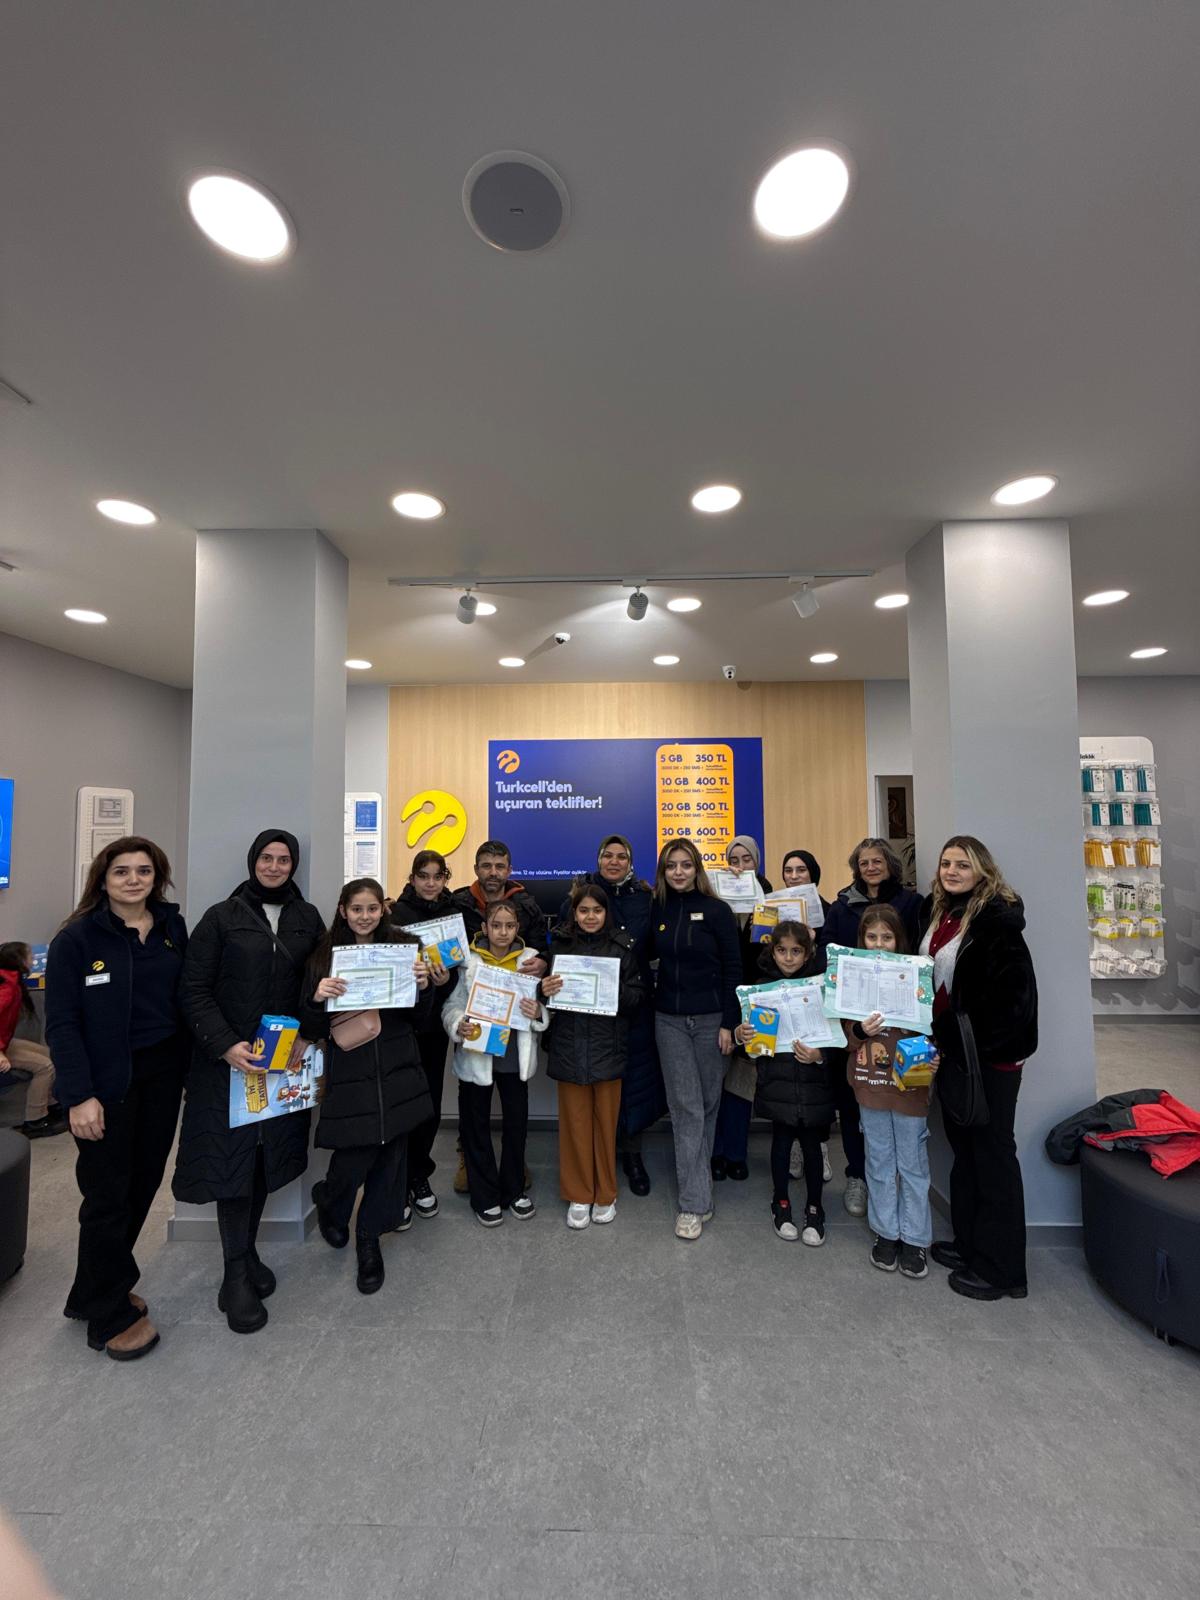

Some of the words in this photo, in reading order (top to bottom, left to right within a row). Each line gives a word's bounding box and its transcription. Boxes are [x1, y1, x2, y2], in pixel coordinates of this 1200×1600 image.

[660, 754, 666, 763] 5
[668, 754, 683, 762] GB
[695, 754, 714, 762] 350
[716, 754, 727, 762] TL
[661, 777, 672, 786] 10
[674, 777, 689, 785] GB
[696, 777, 716, 785] 400
[719, 777, 730, 785] TL
[495, 780, 573, 793] Turkcell'den
[495, 799, 542, 813] uçuran
[545, 796, 603, 809] teklifler!
[661, 802, 674, 811] 20
[676, 802, 691, 811] GB
[696, 802, 716, 811] 500
[718, 802, 729, 811] TL
[661, 827, 674, 836] 30
[677, 827, 691, 836] GB
[696, 827, 717, 836] 600
[719, 827, 730, 836] TL
